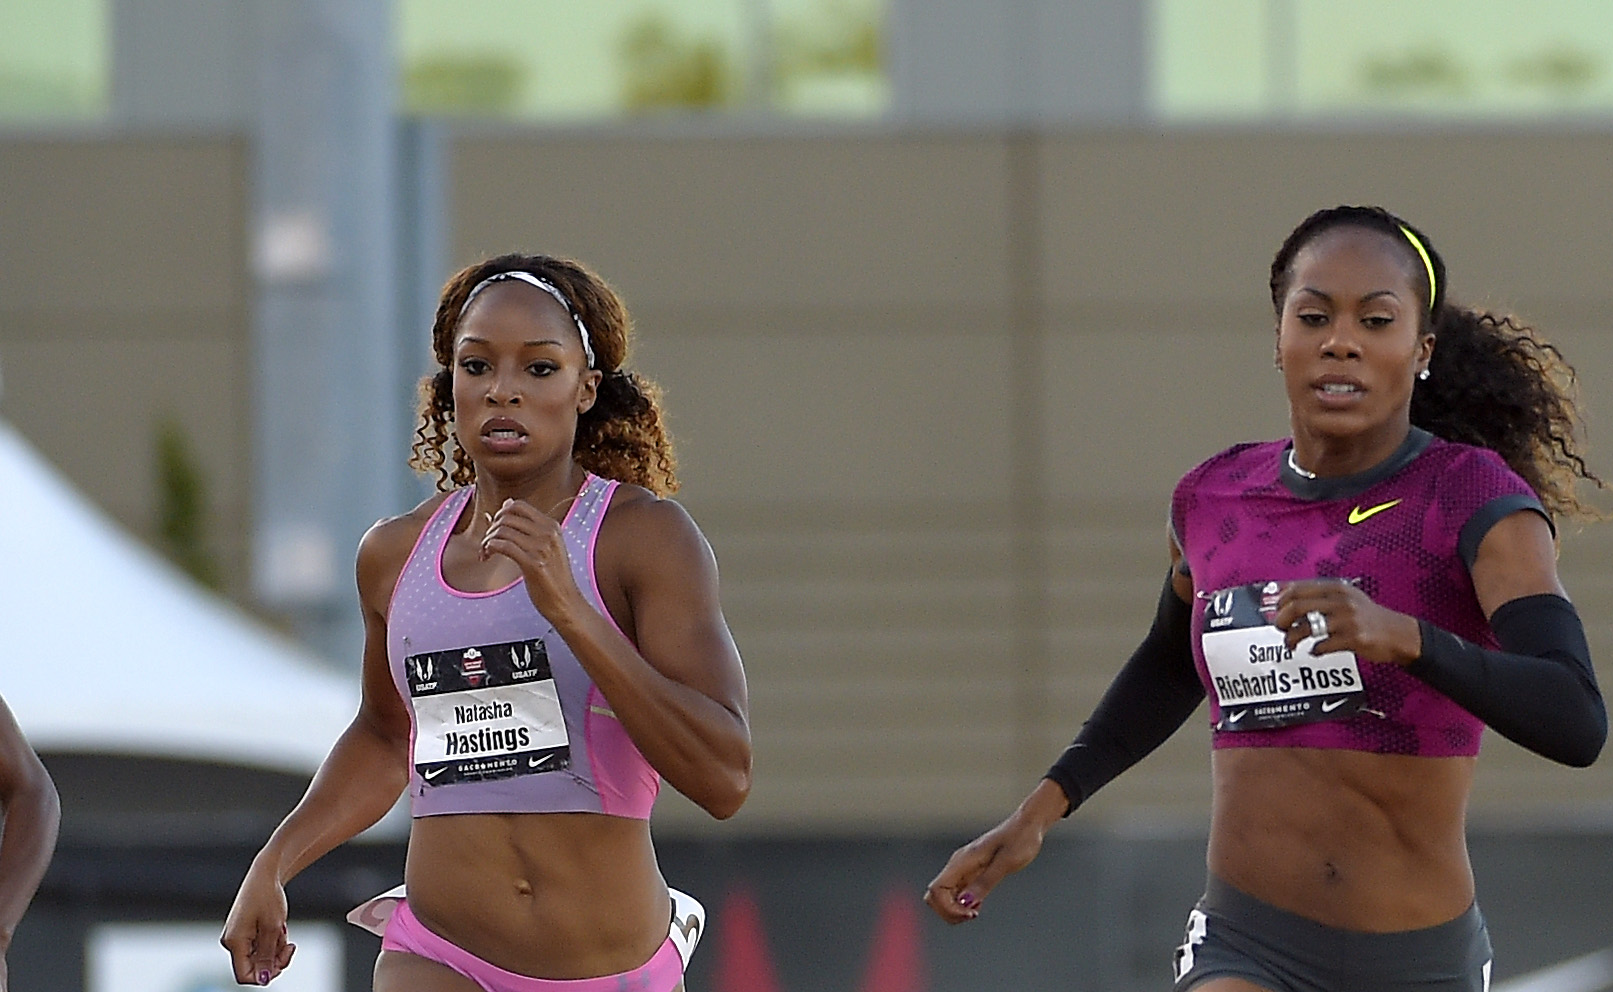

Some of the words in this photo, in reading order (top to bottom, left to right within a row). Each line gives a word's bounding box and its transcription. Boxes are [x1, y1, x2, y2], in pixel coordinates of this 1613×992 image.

[1249, 643, 1293, 664] Sanya
[1215, 666, 1355, 701] Richards-Ross
[454, 701, 513, 725] Natasha
[445, 726, 530, 756] Hastings
